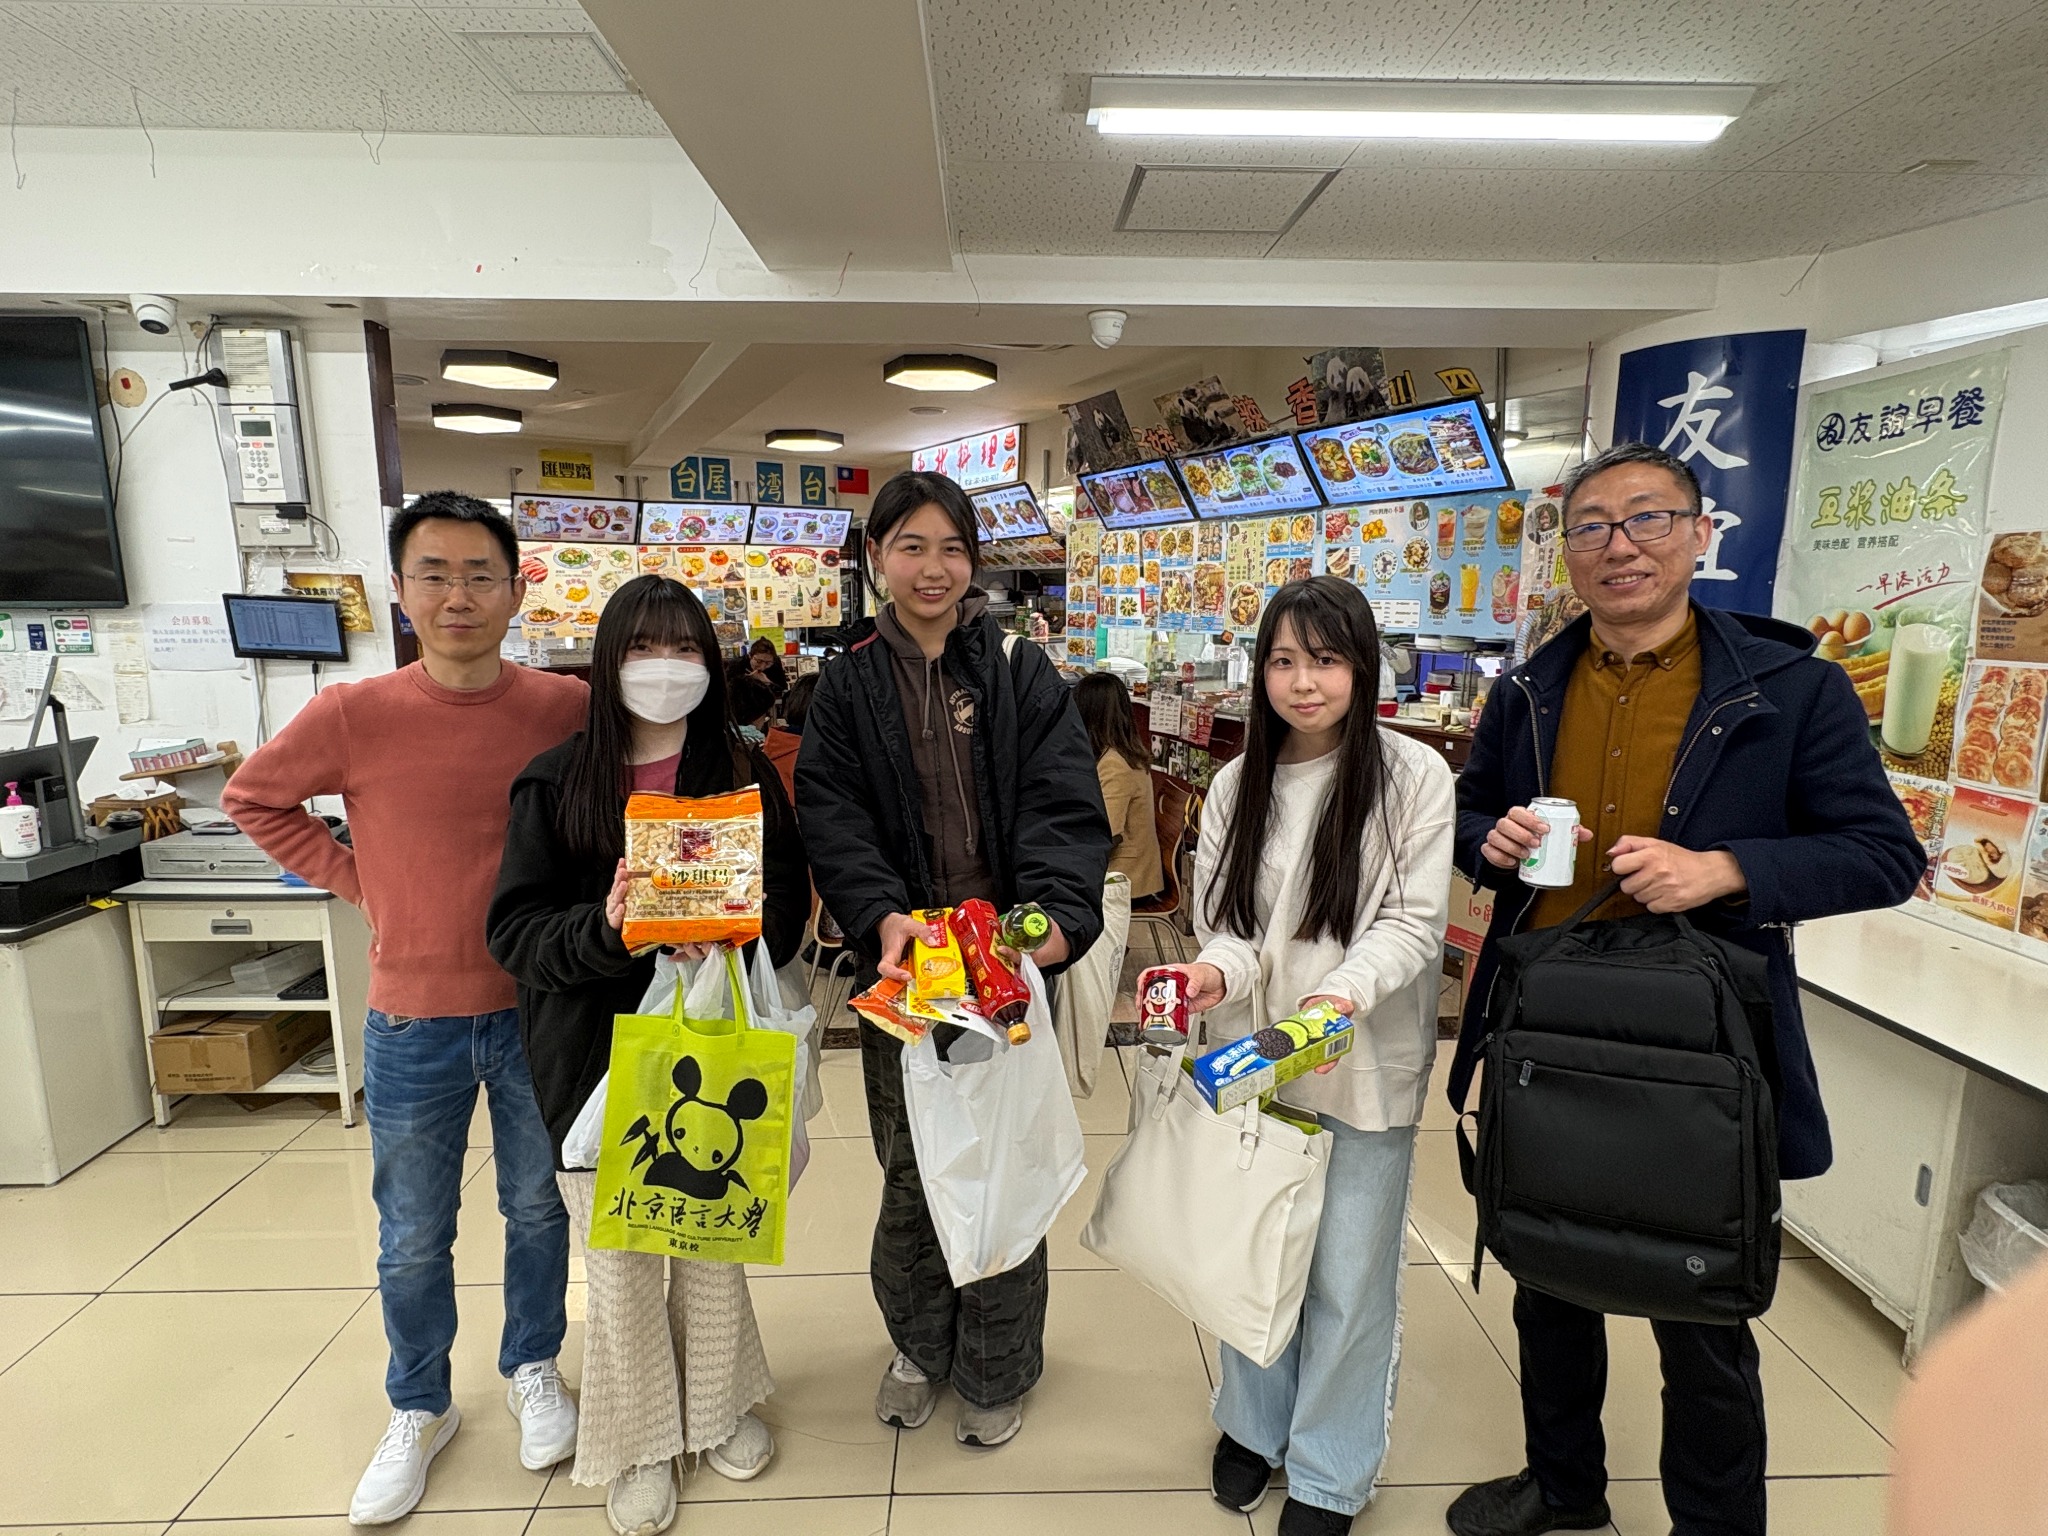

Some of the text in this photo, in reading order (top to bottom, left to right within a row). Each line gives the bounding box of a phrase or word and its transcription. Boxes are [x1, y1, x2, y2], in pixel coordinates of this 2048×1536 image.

[1811, 468, 1968, 530] 豆浆油条
[1812, 534, 1899, 551] 美味绝配 营养搭配
[1856, 563, 1951, 595] 一早添活力
[672, 868, 729, 886] 沙琪玛
[650, 1226, 676, 1235] LANGUAGE
